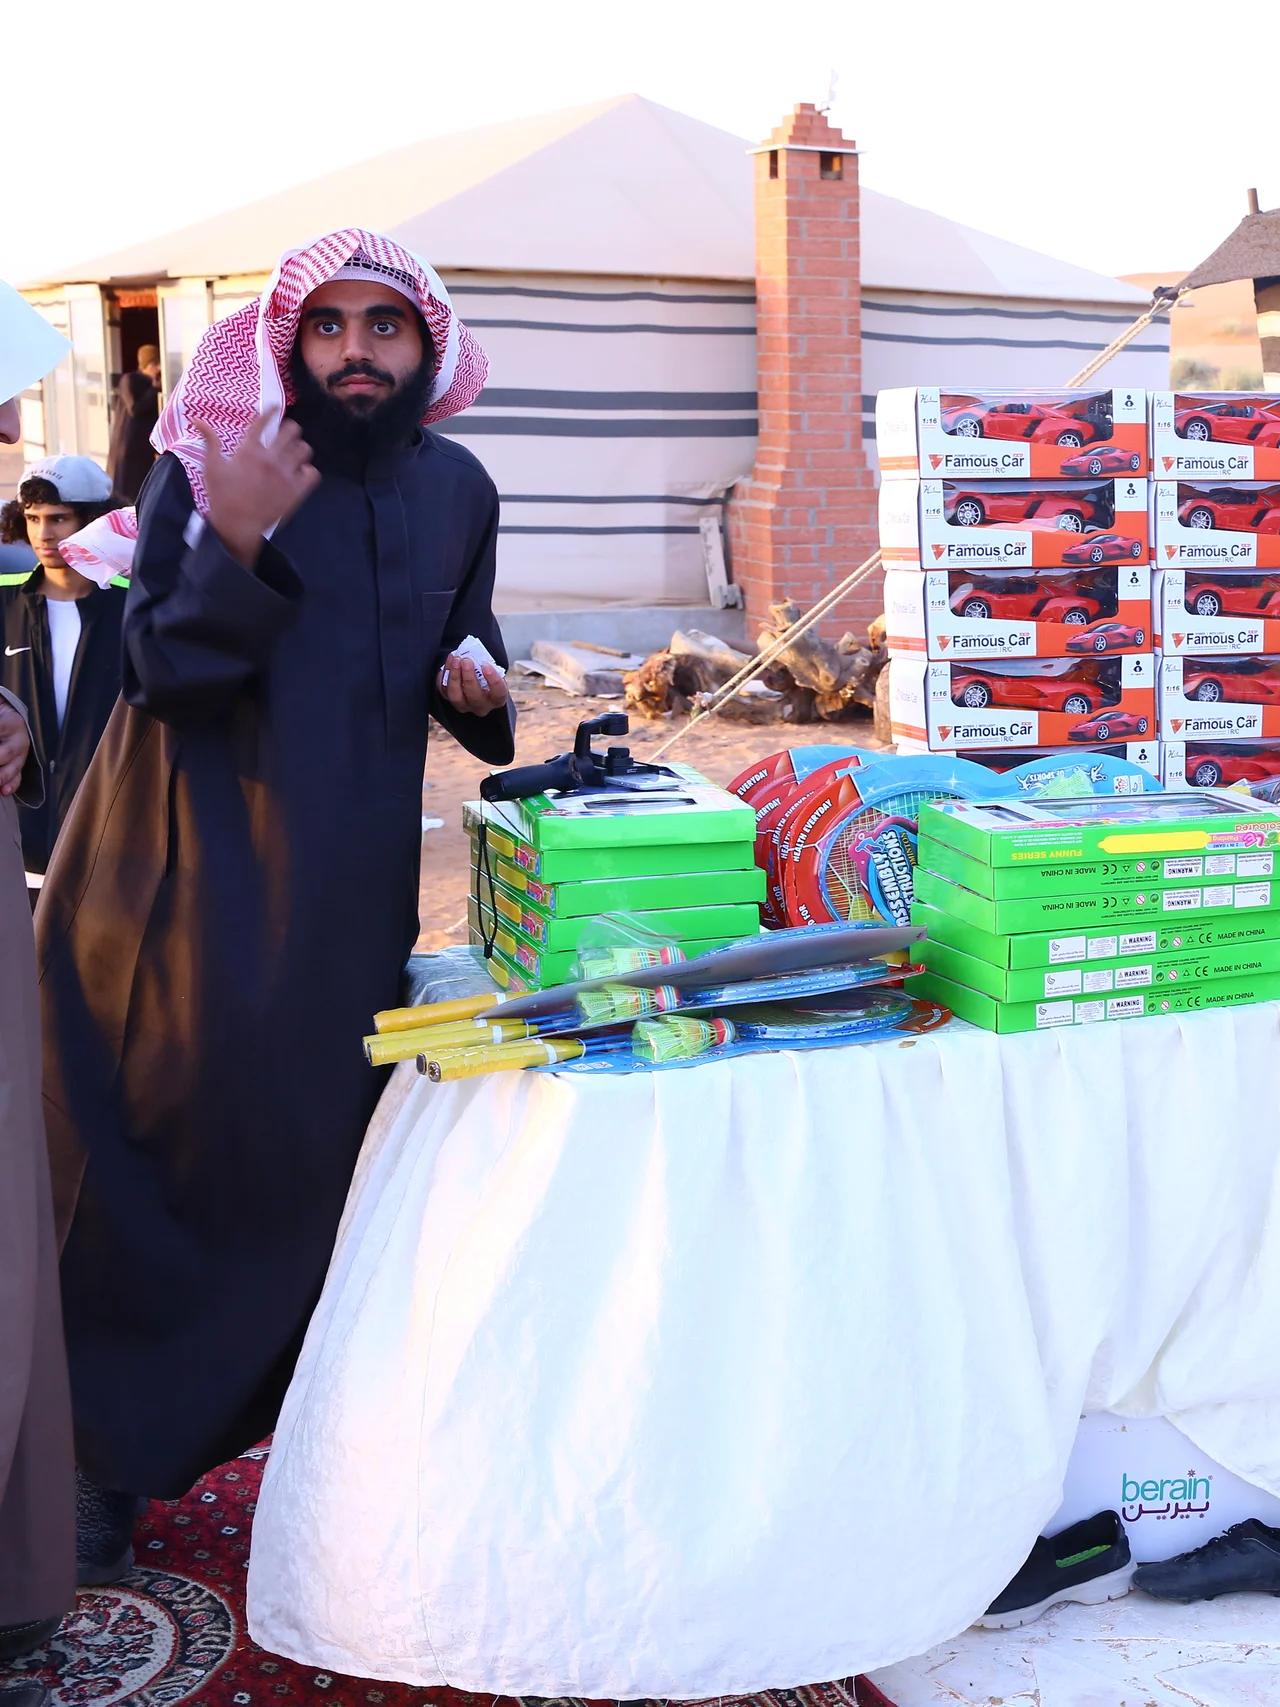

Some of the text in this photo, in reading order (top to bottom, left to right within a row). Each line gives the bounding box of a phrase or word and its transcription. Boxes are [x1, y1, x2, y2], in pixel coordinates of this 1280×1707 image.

[945, 454, 1024, 467] Famous Car
[1177, 457, 1248, 469] Famous Car
[948, 543, 1027, 557] Famous Car
[1180, 545, 1252, 557] Famous Car
[953, 634, 1031, 648] Famous Car
[1187, 631, 1258, 645] Famous Car
[954, 723, 1033, 738] Famous Car
[1185, 717, 1257, 731] Famous Car
[737, 769, 769, 796] EVERYDAY
[1029, 772, 1055, 782] SPORTS
[771, 816, 786, 845] HEALTH
[793, 799, 833, 862] HEALTH EVERYDAY
[1011, 849, 1083, 861] FUNNY SERIES
[881, 830, 914, 909] STRUCTIONS
[1041, 869, 1064, 877] CHINA
[1075, 867, 1097, 875] MADE
[872, 851, 911, 927] ASSEMBLY
[1042, 903, 1065, 911] CHINA
[1076, 900, 1097, 908] MADE
[798, 904, 811, 920] FOR
[1217, 931, 1236, 940] MADE
[1246, 929, 1266, 937] CHINA
[1214, 964, 1233, 973] MADE
[1242, 961, 1262, 969] CHINA
[1206, 995, 1225, 1003] MADE
[1234, 992, 1255, 1000] CHINA
[1122, 1469, 1210, 1502] berain
[1122, 1501, 1210, 1522] بيرين
